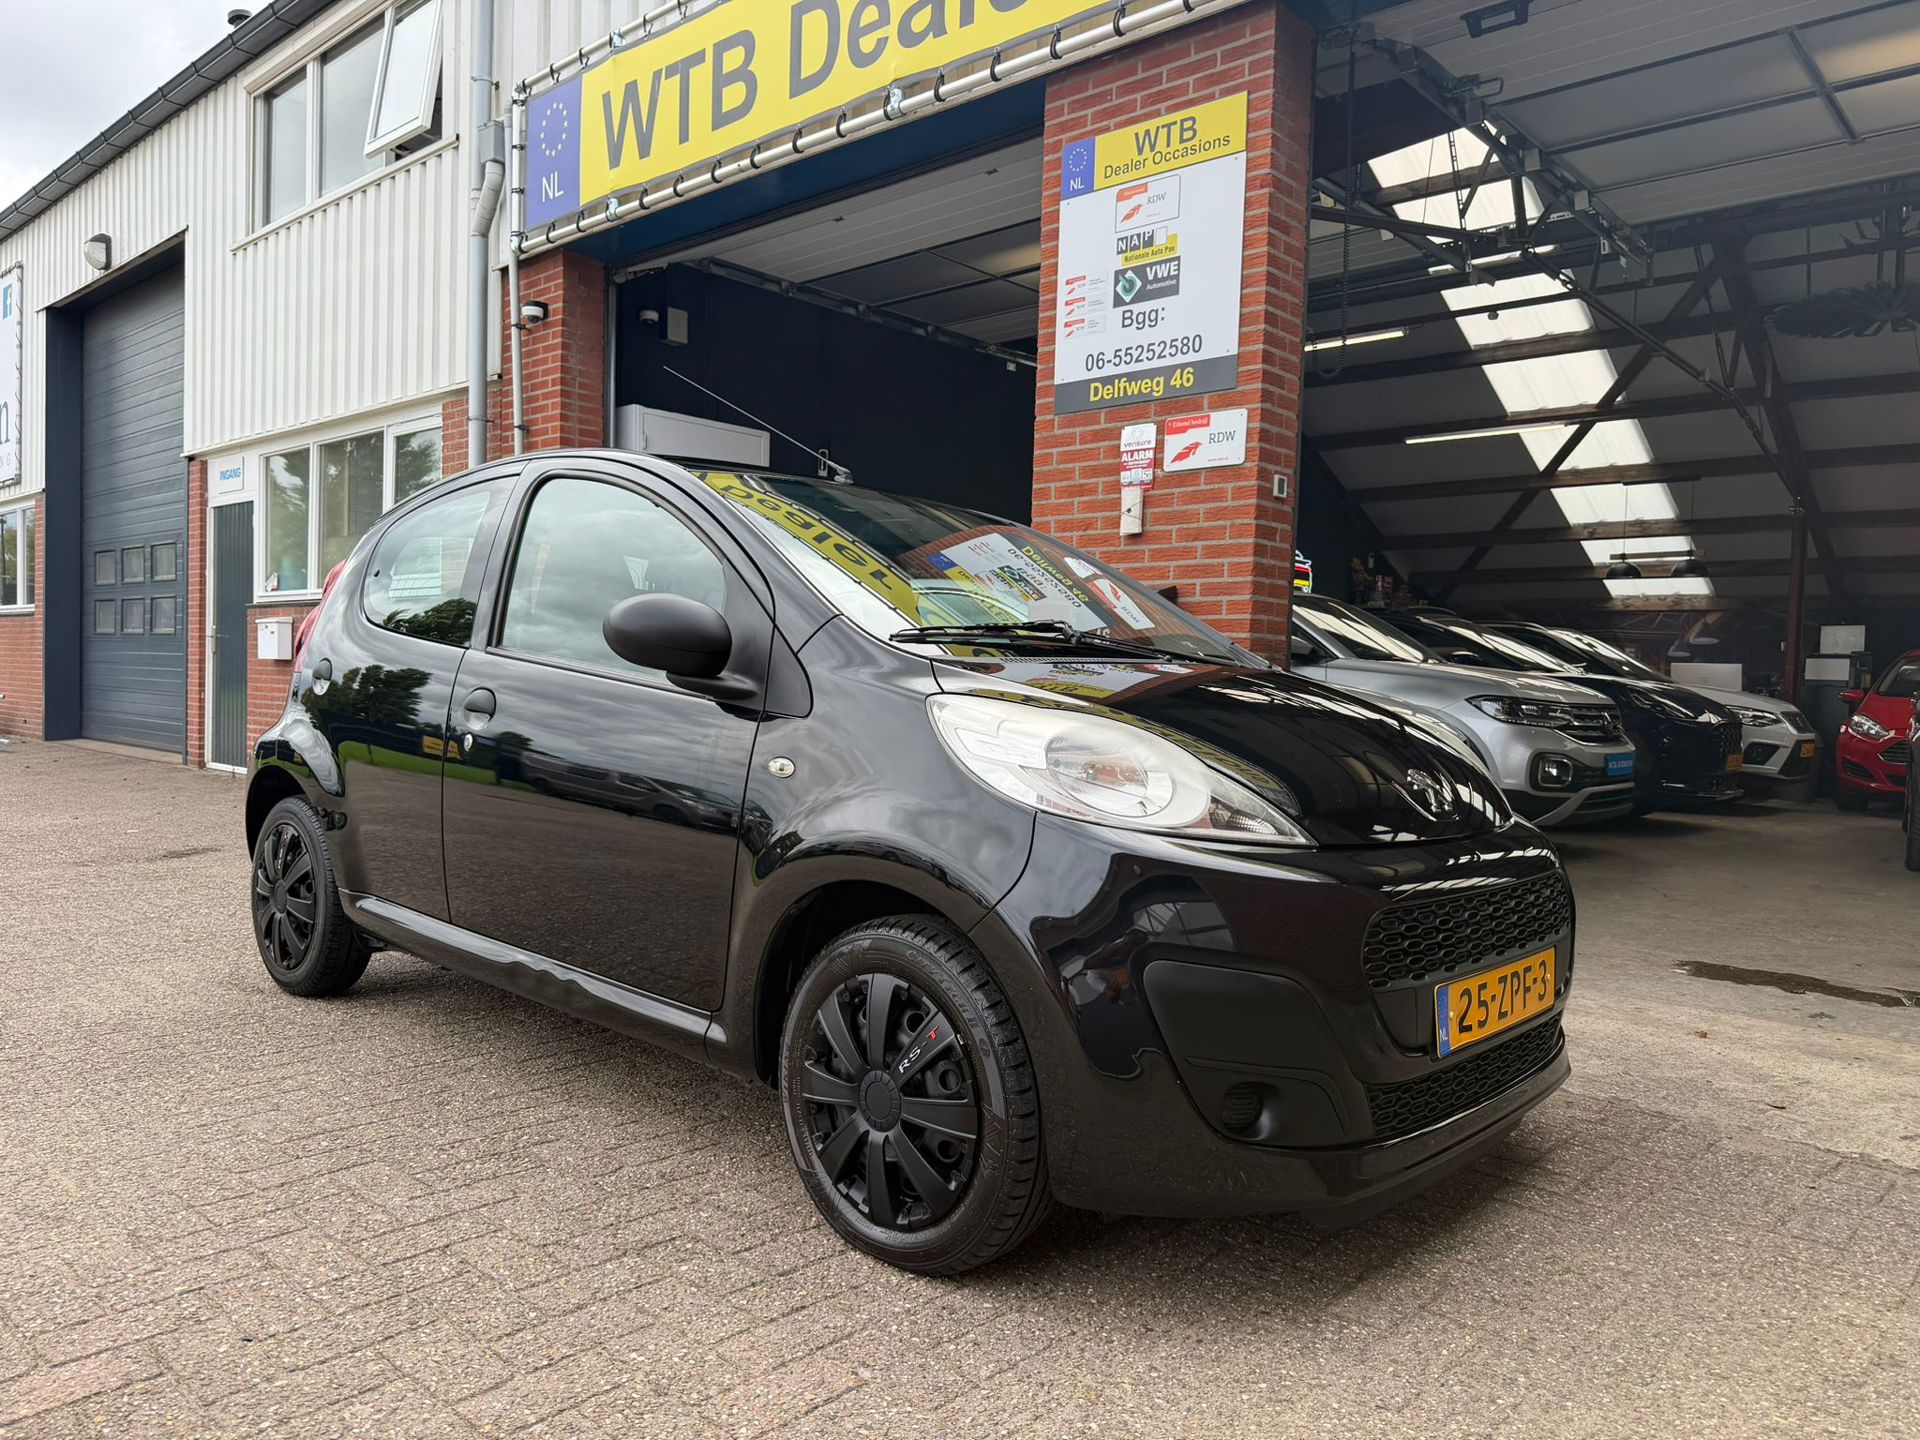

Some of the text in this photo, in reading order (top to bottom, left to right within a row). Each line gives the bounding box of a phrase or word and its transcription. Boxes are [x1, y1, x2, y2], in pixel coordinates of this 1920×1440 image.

[602, 0, 1030, 170] WTB Dea
[1134, 116, 1198, 156] WTB
[1104, 134, 1231, 179] Dealer Occasions
[542, 171, 564, 203] NL
[1070, 177, 1085, 191] NL
[1146, 192, 1167, 205] RDW
[1117, 229, 1154, 252] NAP
[1151, 247, 1164, 257] Auto
[1146, 261, 1179, 280] VWE
[1146, 279, 1177, 291] Automotive
[1121, 306, 1166, 330] Bgg:
[1085, 334, 1203, 372] 06-55252580
[1089, 367, 1195, 402] Delfweg 46
[1208, 430, 1237, 444] RDW
[1121, 450, 1154, 462] ALARM
[219, 467, 241, 481] INGANG
[1458, 959, 1548, 1034] 25-ZPF-3
[1440, 1028, 1449, 1042] NL
